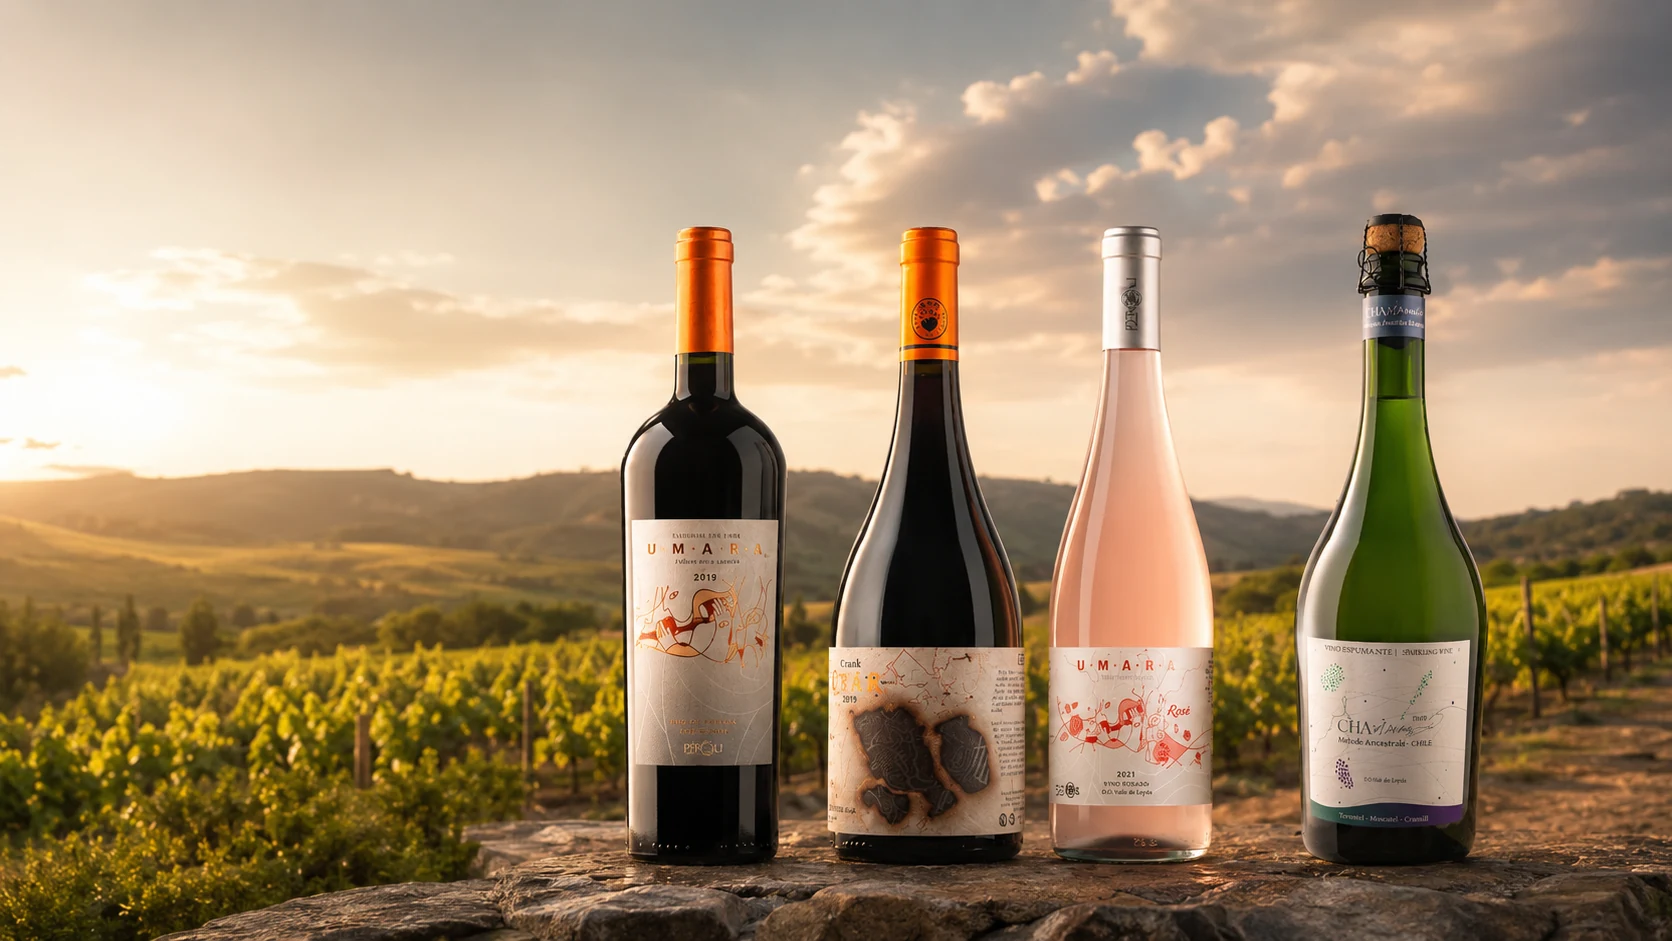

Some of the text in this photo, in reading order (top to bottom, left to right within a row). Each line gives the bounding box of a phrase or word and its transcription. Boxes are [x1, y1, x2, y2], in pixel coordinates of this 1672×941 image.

[693, 573, 717, 582] 2019
[1324, 644, 1393, 656] VINO ESPUMANTE
[840, 658, 862, 668] Crank
[842, 695, 858, 704] 2019
[1166, 704, 1191, 718] Rosé
